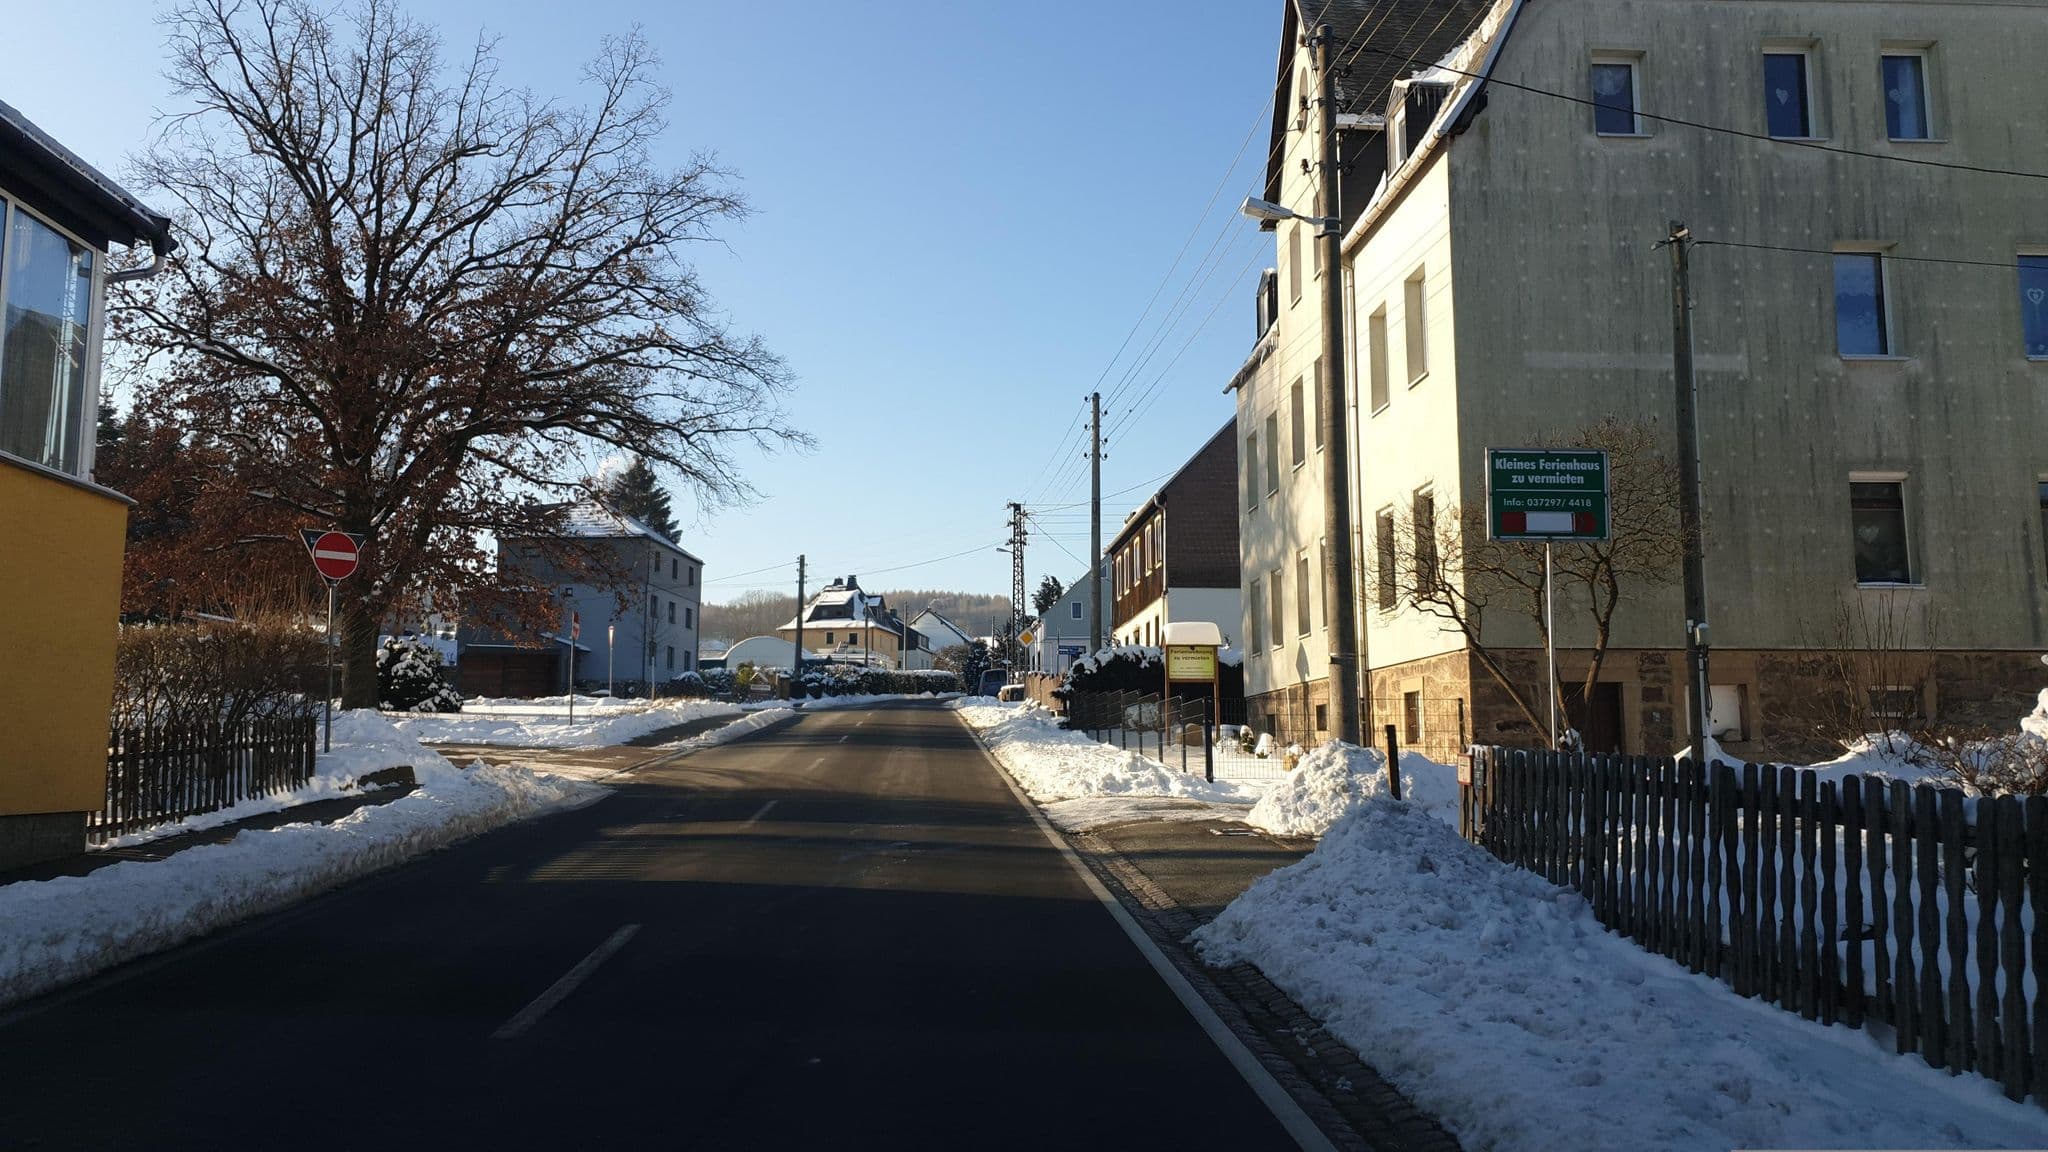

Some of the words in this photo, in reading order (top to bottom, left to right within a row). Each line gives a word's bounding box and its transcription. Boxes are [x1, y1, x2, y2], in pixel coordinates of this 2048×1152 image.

[1495, 458, 1536, 470] Kleines
[1539, 458, 1600, 470] Ferienhaus
[1512, 474, 1525, 483] zu
[1528, 472, 1584, 484] vermieten
[1503, 498, 1524, 507] Info:
[1568, 498, 1592, 507] 4418
